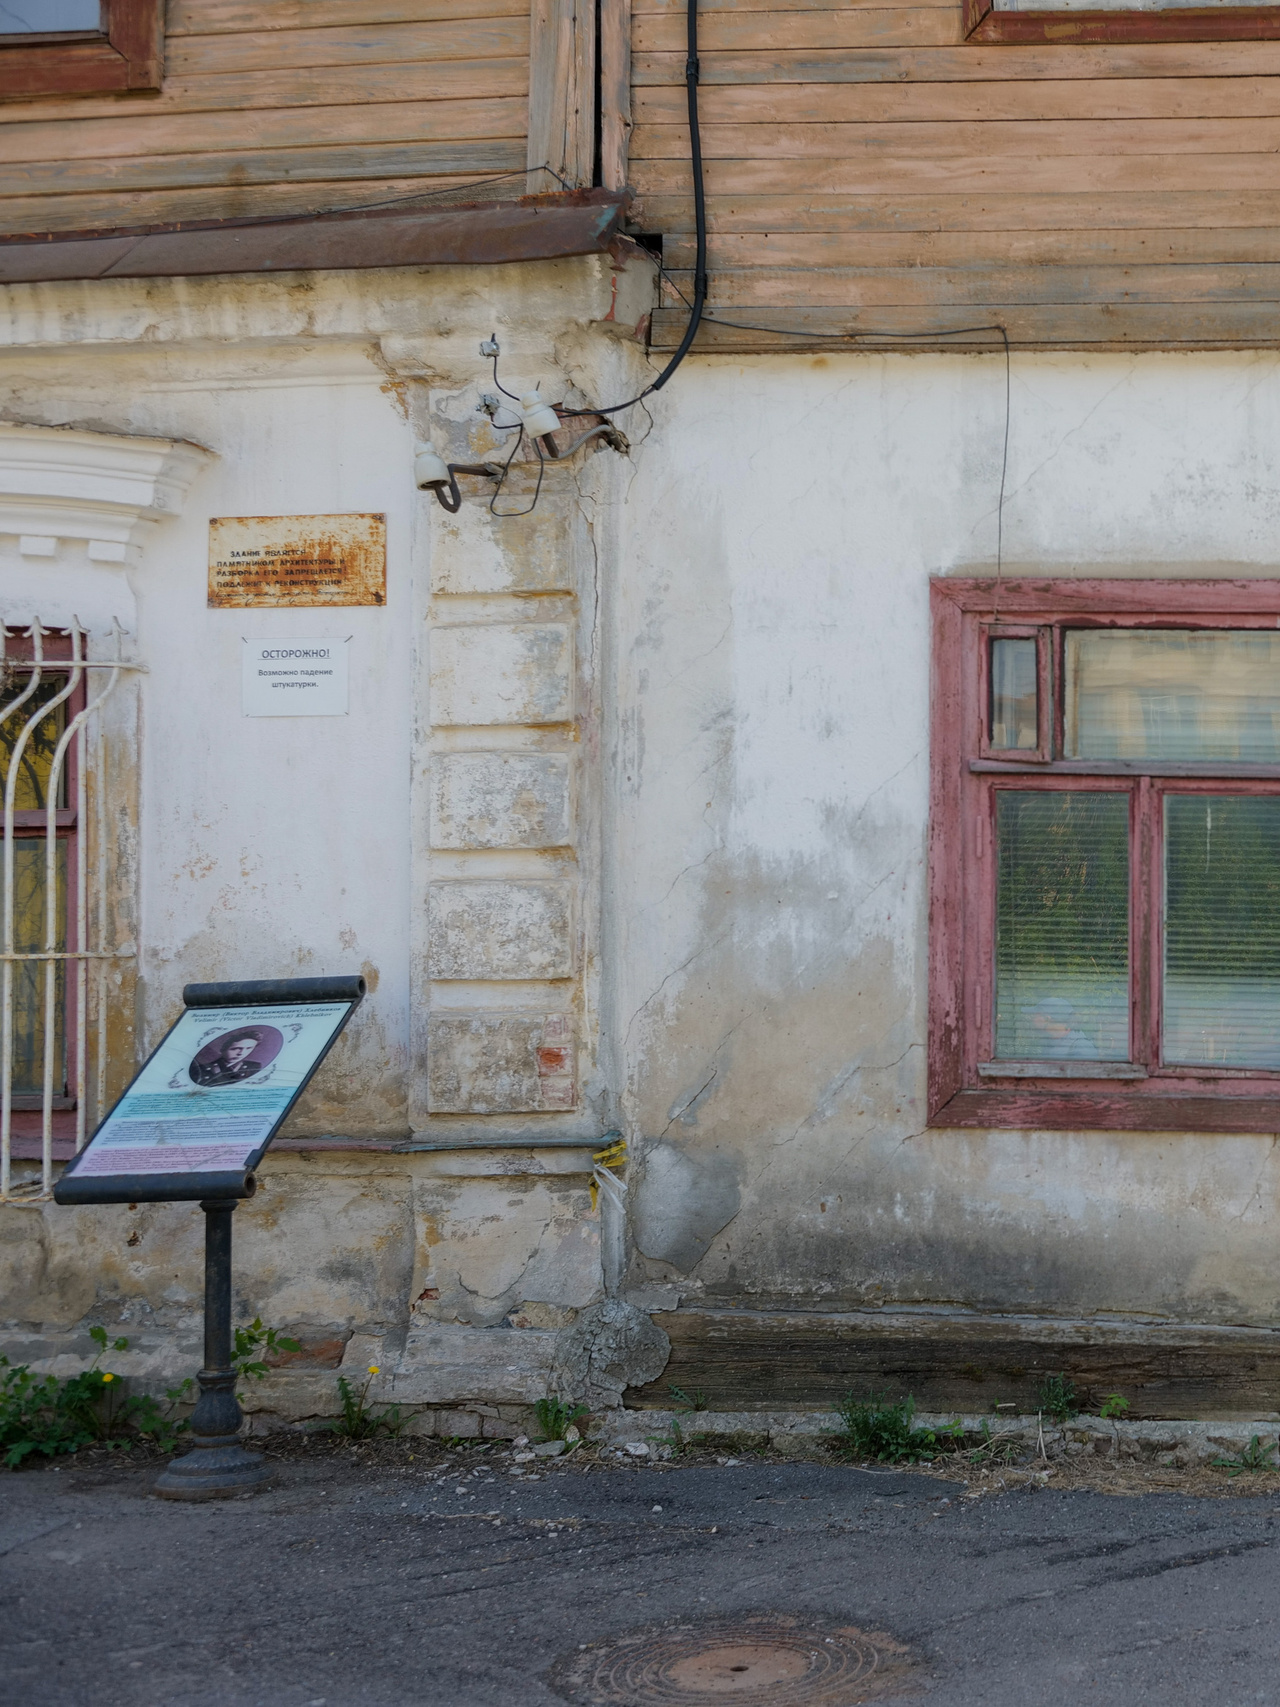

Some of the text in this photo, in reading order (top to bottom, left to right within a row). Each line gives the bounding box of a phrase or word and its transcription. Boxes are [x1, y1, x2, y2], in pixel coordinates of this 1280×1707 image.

[230, 549, 306, 558] ЗДАНИЕ ЯВЛЯЕТСЯ
[216, 560, 275, 568] ПАМЯТНИКОМ
[279, 558, 336, 566] АРХИТЕКТУРЫ
[216, 569, 260, 577] РАЗБОРКА
[274, 579, 342, 588] РЕКОНСТРУКЦИИ
[261, 648, 331, 659] ОСТОРОЖНО!
[258, 668, 334, 677] Возможно падение
[271, 681, 319, 689] штукатурки.
